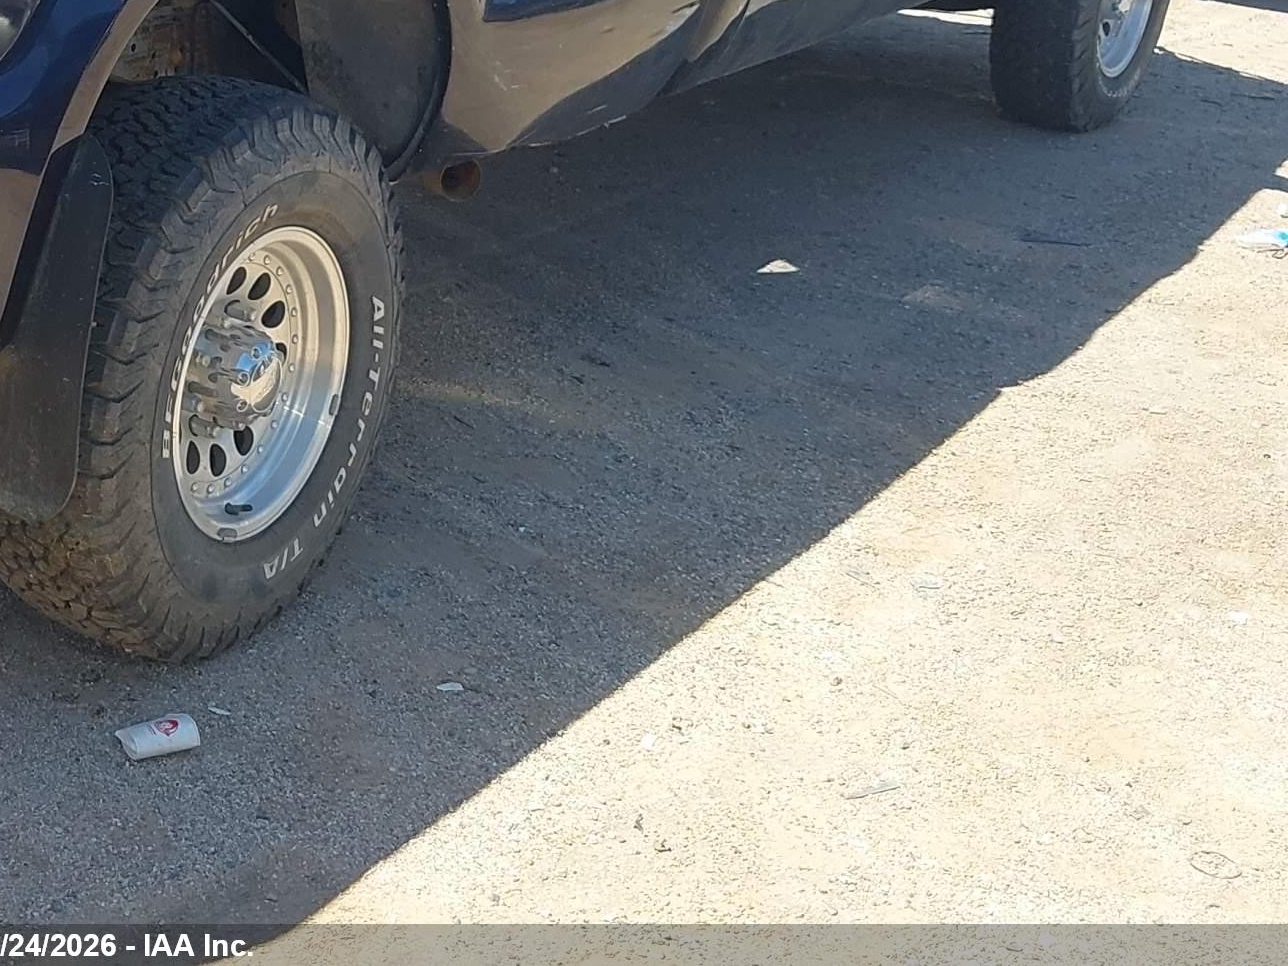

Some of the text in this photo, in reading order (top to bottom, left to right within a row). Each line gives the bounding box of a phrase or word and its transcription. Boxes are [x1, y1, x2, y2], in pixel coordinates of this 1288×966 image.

[162, 203, 278, 459] BFGoodrich
[263, 296, 385, 579] All-Terrain T/A
